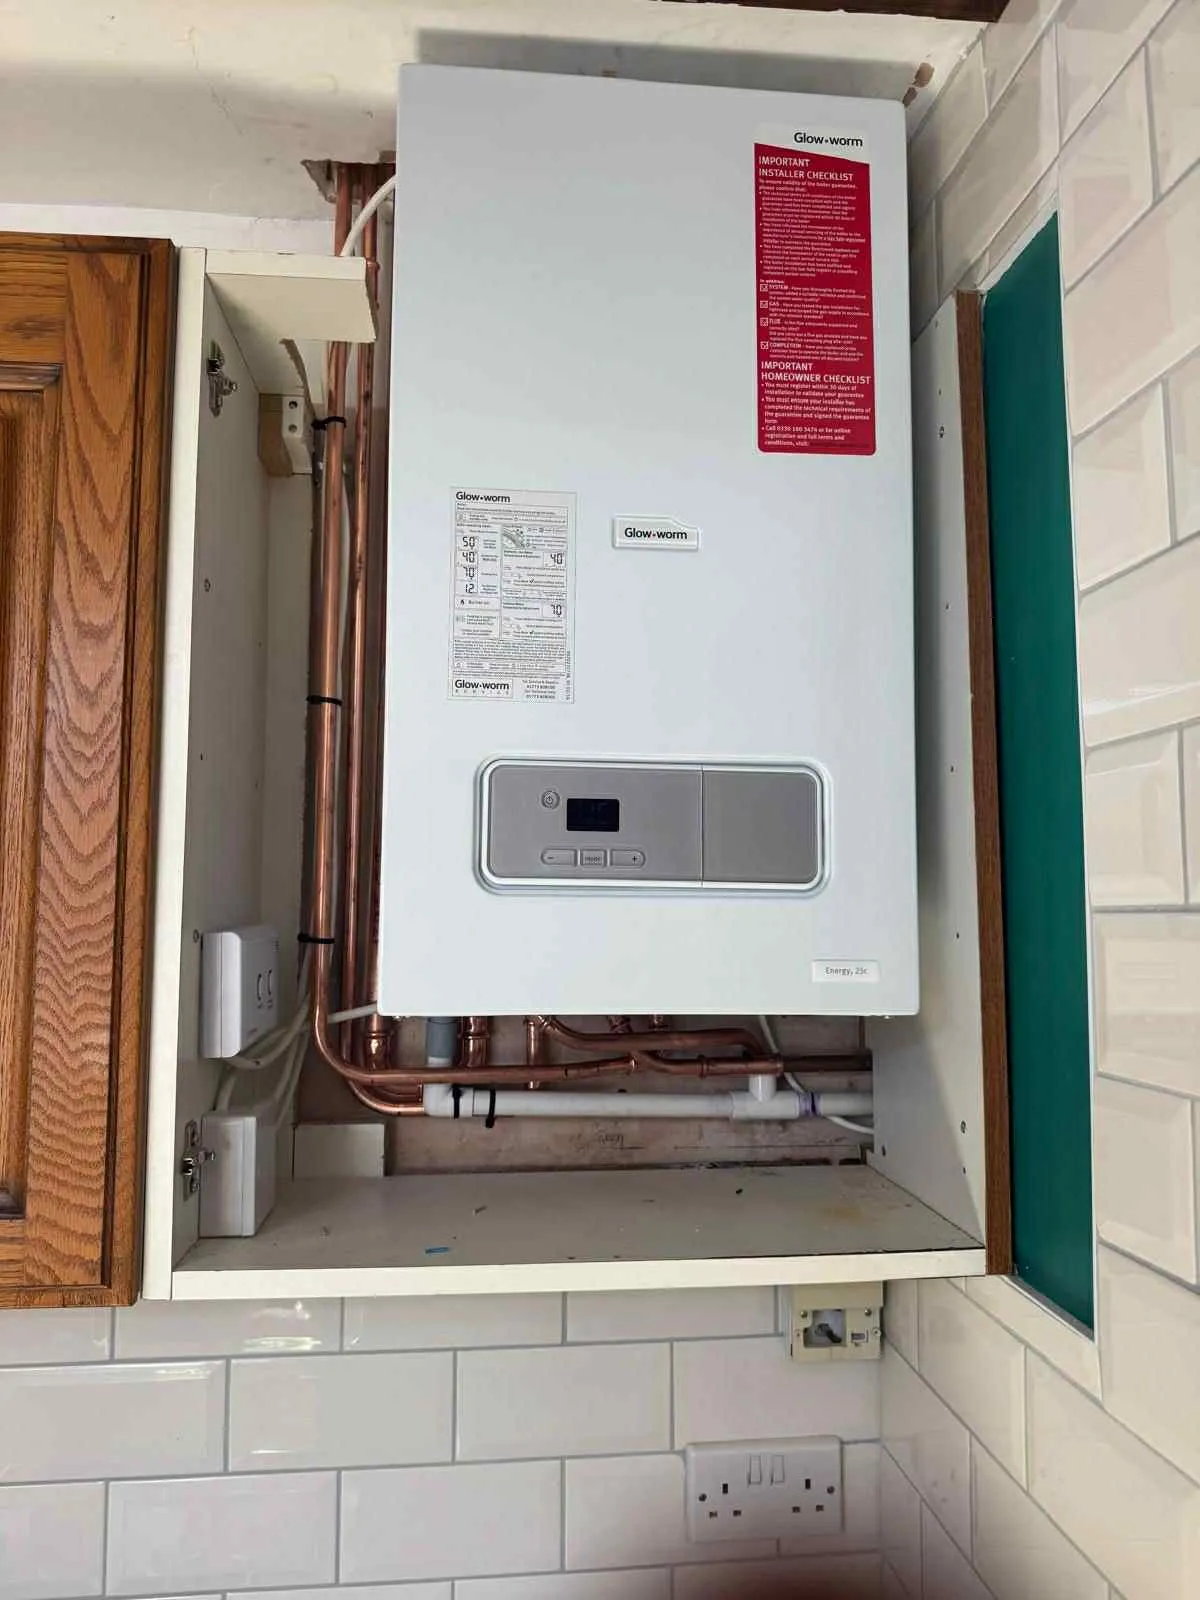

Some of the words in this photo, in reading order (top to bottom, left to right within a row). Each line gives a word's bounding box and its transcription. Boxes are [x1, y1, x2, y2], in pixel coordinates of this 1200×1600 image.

[759, 156, 811, 167] IMPORTANT
[759, 168, 804, 178] INSTALLER
[806, 170, 854, 181] CHECKLIST
[761, 361, 814, 370] IMPORTANT
[761, 372, 820, 382] HOMEOWNER
[823, 374, 871, 384] CHECKLIST
